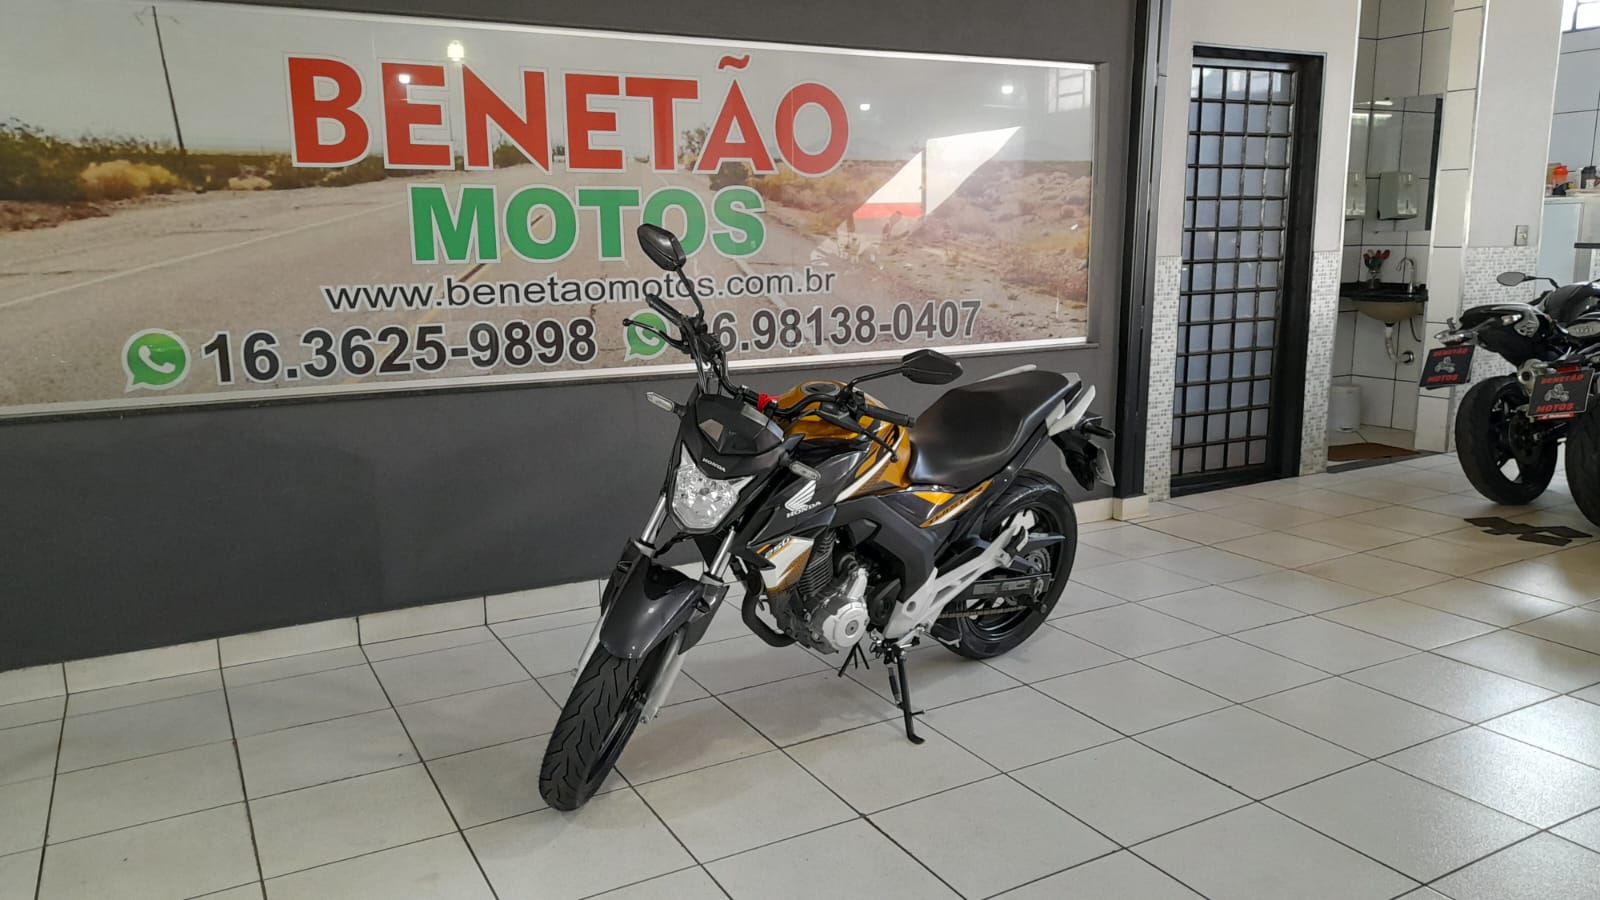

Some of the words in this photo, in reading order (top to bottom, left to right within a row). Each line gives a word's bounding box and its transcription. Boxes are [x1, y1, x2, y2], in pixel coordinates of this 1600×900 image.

[287, 55, 849, 174] BENETÃO
[411, 184, 766, 264] MOTOS
[323, 267, 836, 311] www.benetaomotos.com.br
[709, 300, 981, 351] 6.98138-0407
[203, 320, 597, 384] 16.3625-9898
[702, 457, 726, 472] HONDA
[786, 501, 822, 518] HONDA
